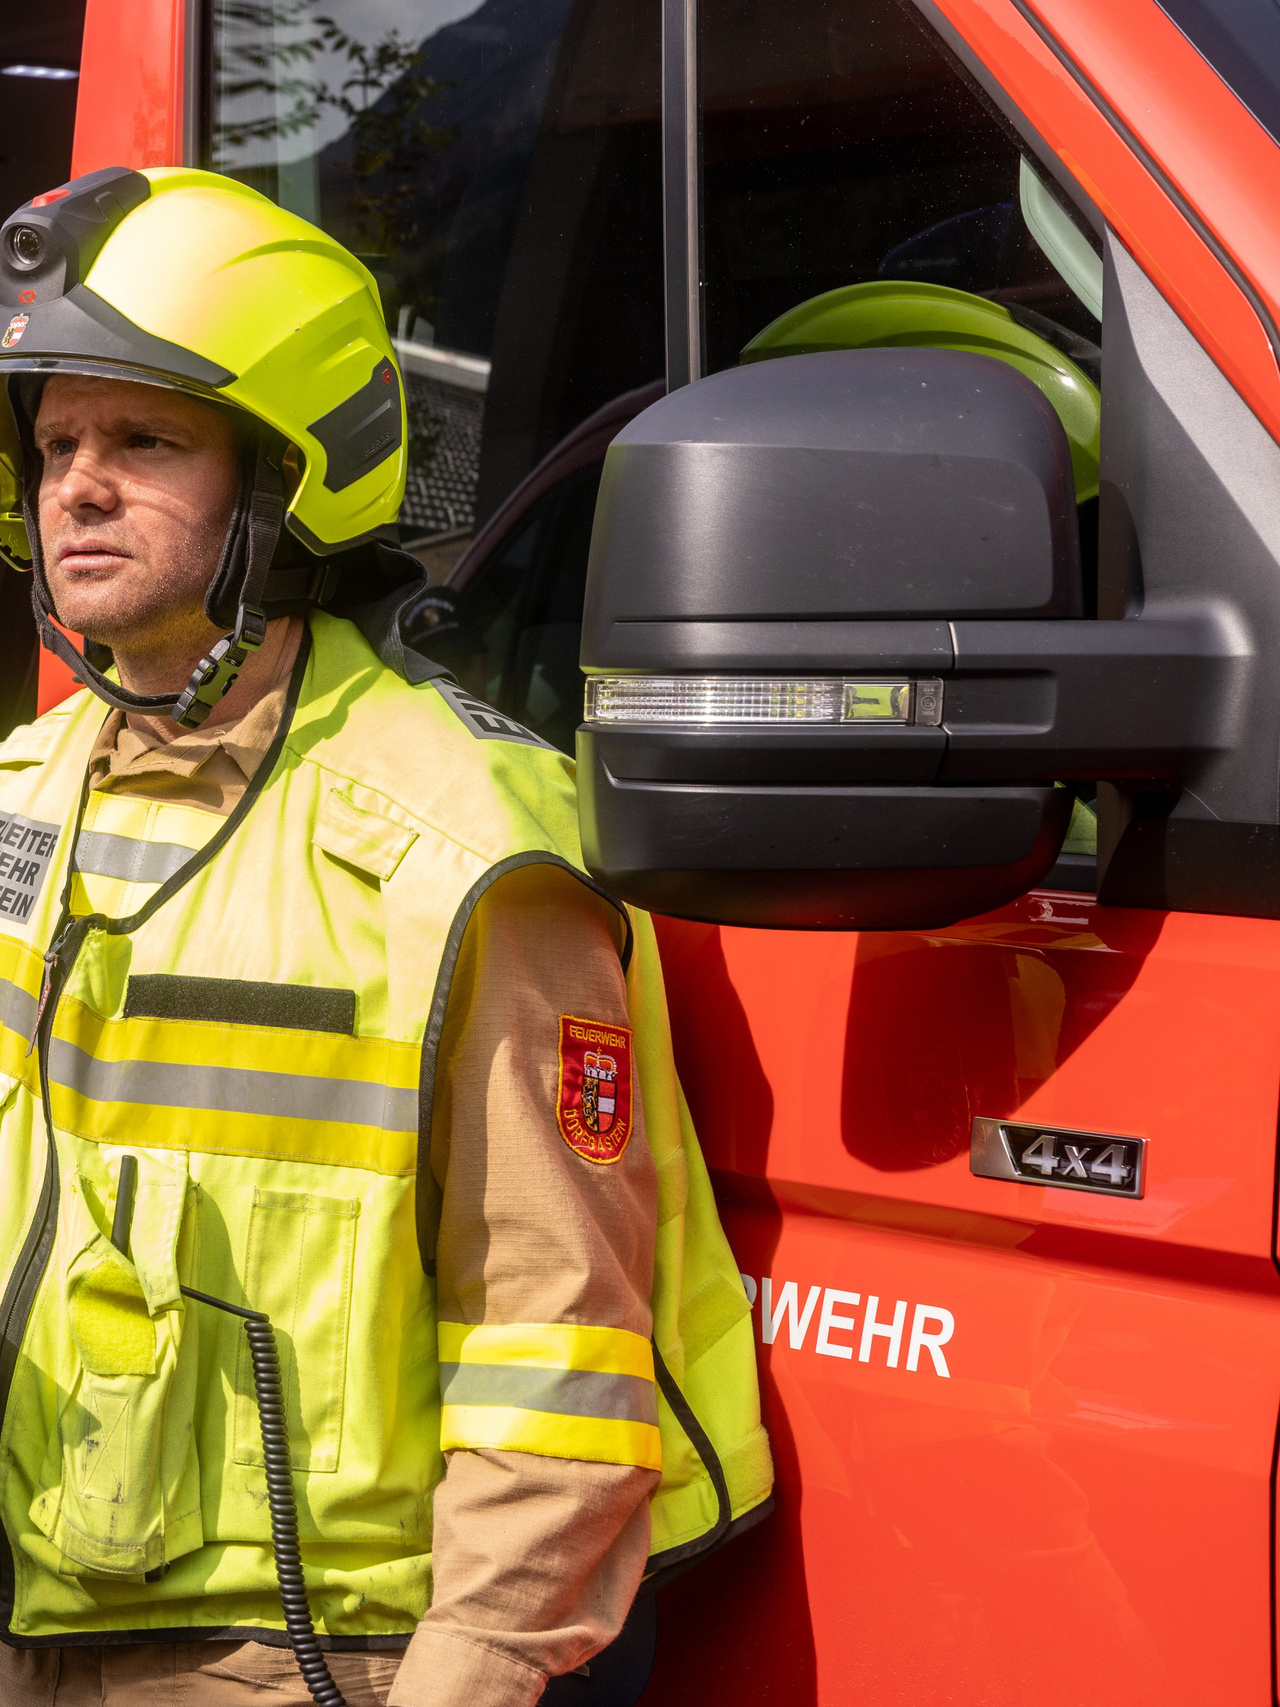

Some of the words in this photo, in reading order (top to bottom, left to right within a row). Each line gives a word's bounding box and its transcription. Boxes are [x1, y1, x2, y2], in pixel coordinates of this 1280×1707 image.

[569, 1025, 627, 1049] FEUERWEHR
[564, 1108, 627, 1152] DORFGASTEIN
[1021, 1134, 1132, 1185] 4x4
[740, 1273, 955, 1379] WEHR
